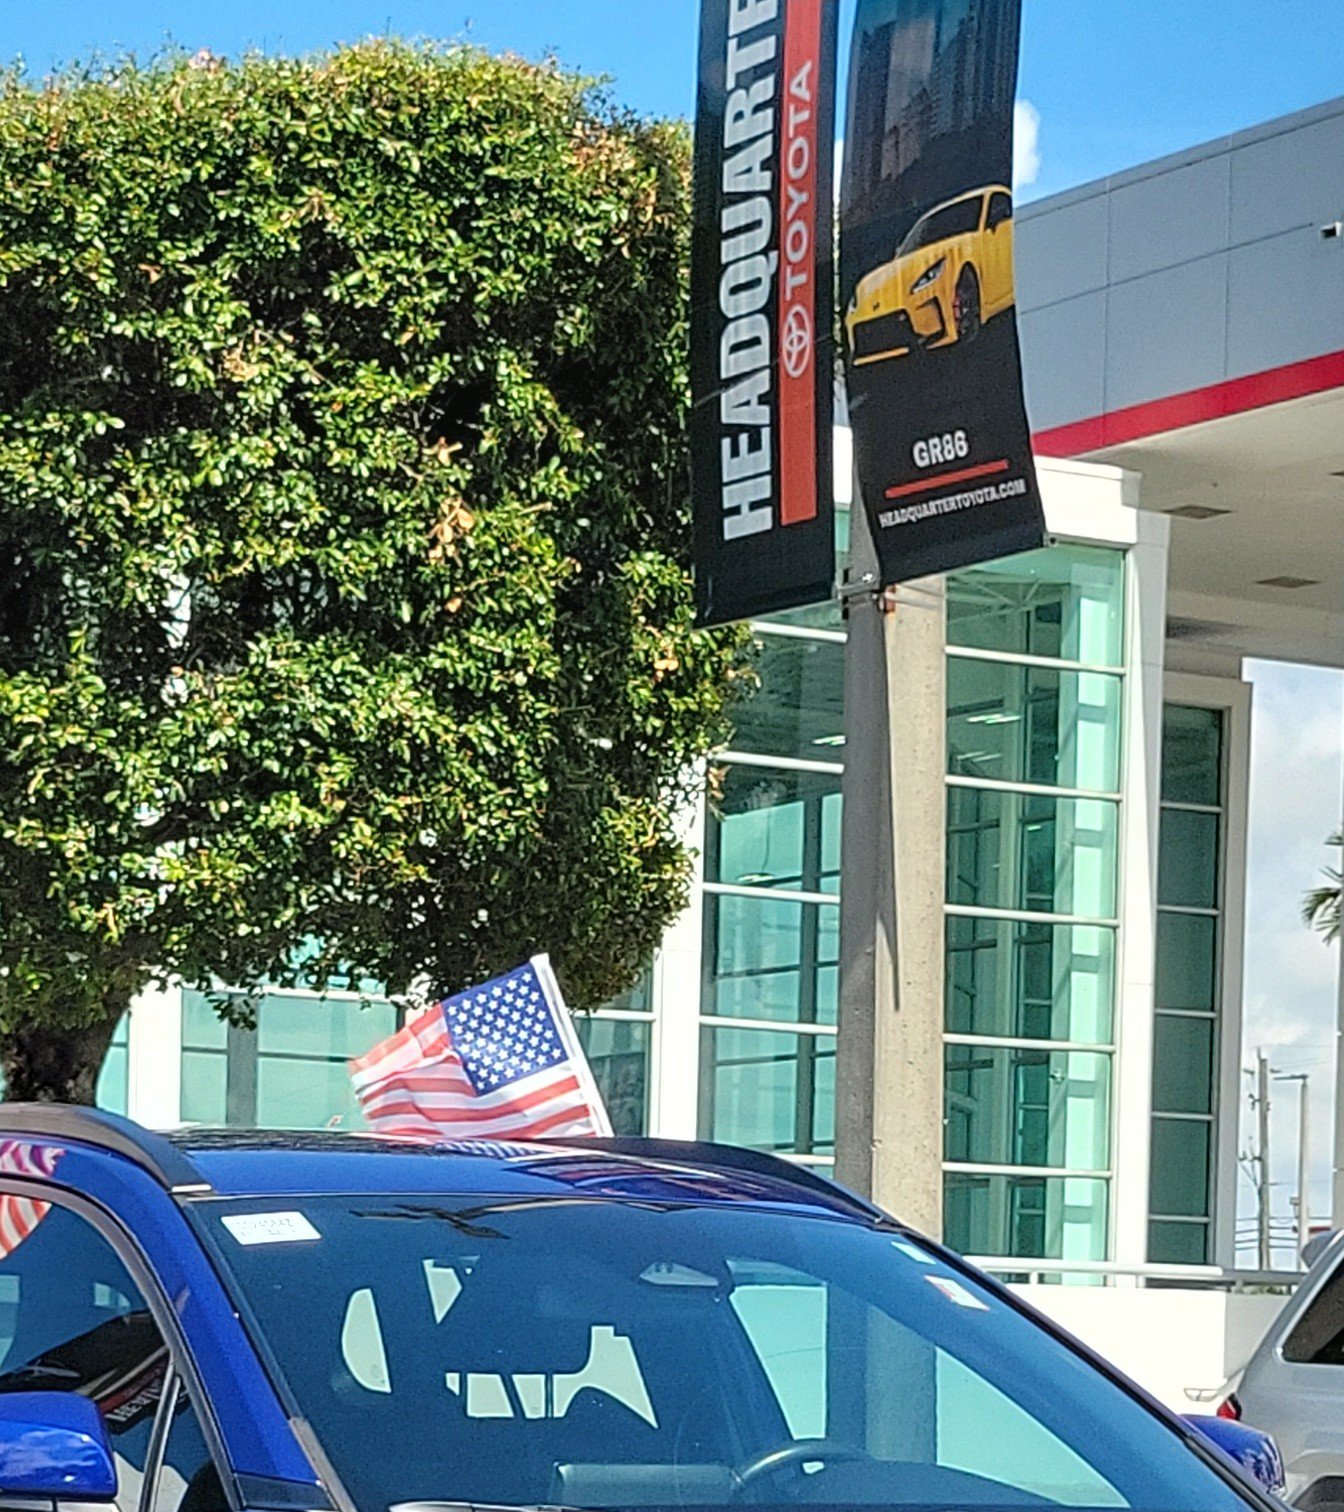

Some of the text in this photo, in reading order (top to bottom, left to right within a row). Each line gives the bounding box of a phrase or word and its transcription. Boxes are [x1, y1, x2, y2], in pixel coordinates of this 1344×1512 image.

[785, 60, 813, 288] TOYOTA
[913, 430, 969, 468] GR86
[878, 478, 1027, 529] HEADQUARTERTOYOTA.COM
